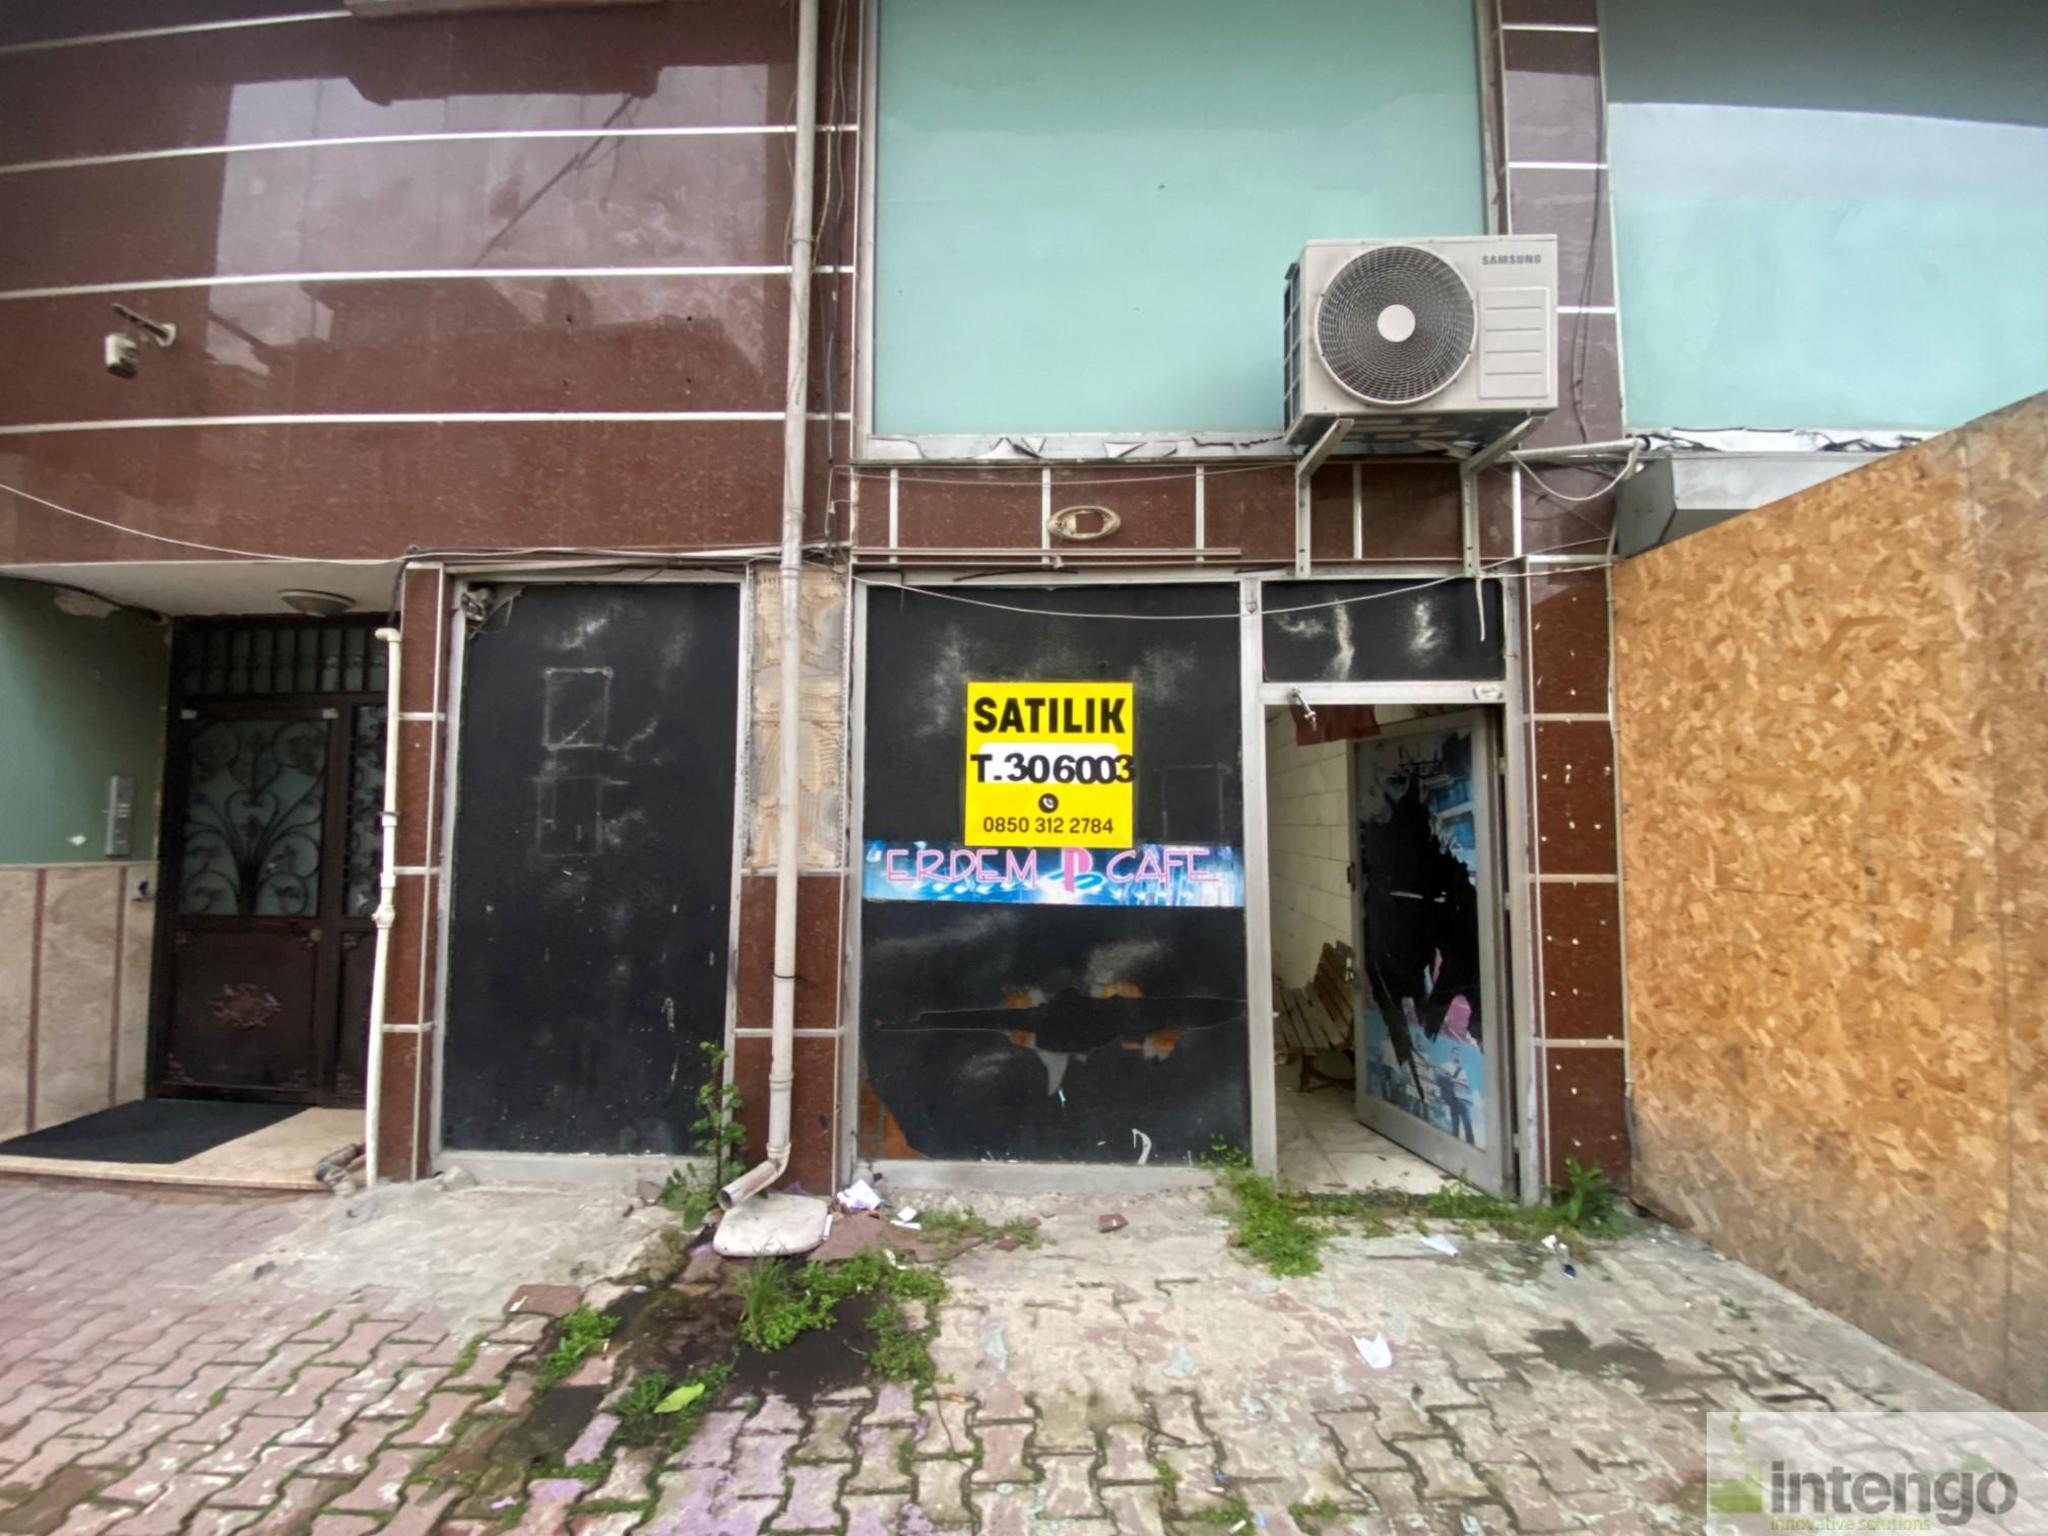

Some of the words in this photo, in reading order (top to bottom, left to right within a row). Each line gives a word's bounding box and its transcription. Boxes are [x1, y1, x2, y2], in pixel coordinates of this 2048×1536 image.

[1482, 254, 1542, 265] SAMSUNG
[973, 696, 1126, 734] SATILIK
[970, 752, 1136, 784] T.306003
[983, 816, 1029, 833] 0850
[1035, 817, 1064, 833] 312
[1069, 817, 1113, 834] 2784
[886, 848, 1038, 888] ERDEM
[1106, 848, 1218, 888] CAFE
